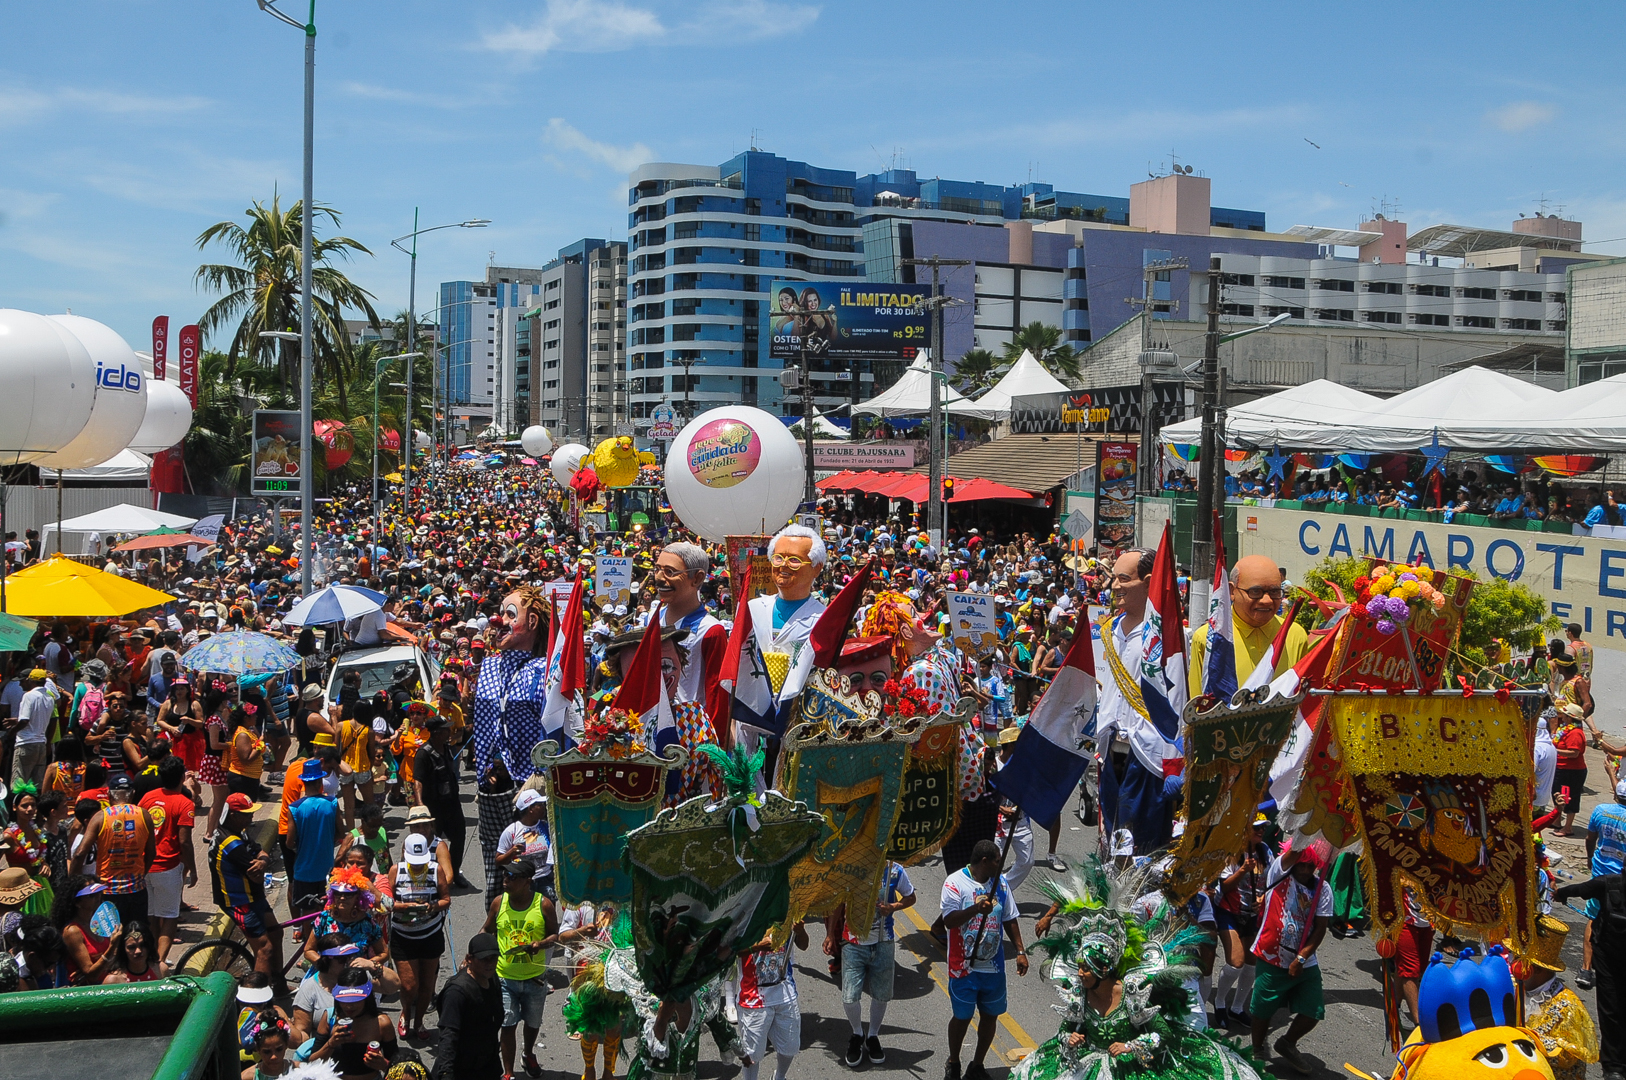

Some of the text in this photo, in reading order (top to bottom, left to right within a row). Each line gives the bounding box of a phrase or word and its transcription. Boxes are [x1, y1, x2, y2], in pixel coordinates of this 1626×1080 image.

[840, 292, 924, 308] ILIMITADO
[875, 307, 892, 315] POR
[893, 308, 904, 316] 30
[773, 335, 814, 344] OSTENE
[691, 442, 748, 467] cuidado
[857, 448, 906, 456] PAJUSSARA
[266, 481, 288, 491] 11:09
[1299, 519, 1626, 598] CAMAROTE
[954, 595, 987, 606] CAIXA
[1536, 601, 1626, 639] EIR
[1212, 722, 1273, 752] B C
[1380, 713, 1458, 744] B C
[926, 733, 941, 750] C
[570, 770, 639, 787] B C
[1369, 822, 1524, 905] PINTO DA MADRUGADA
